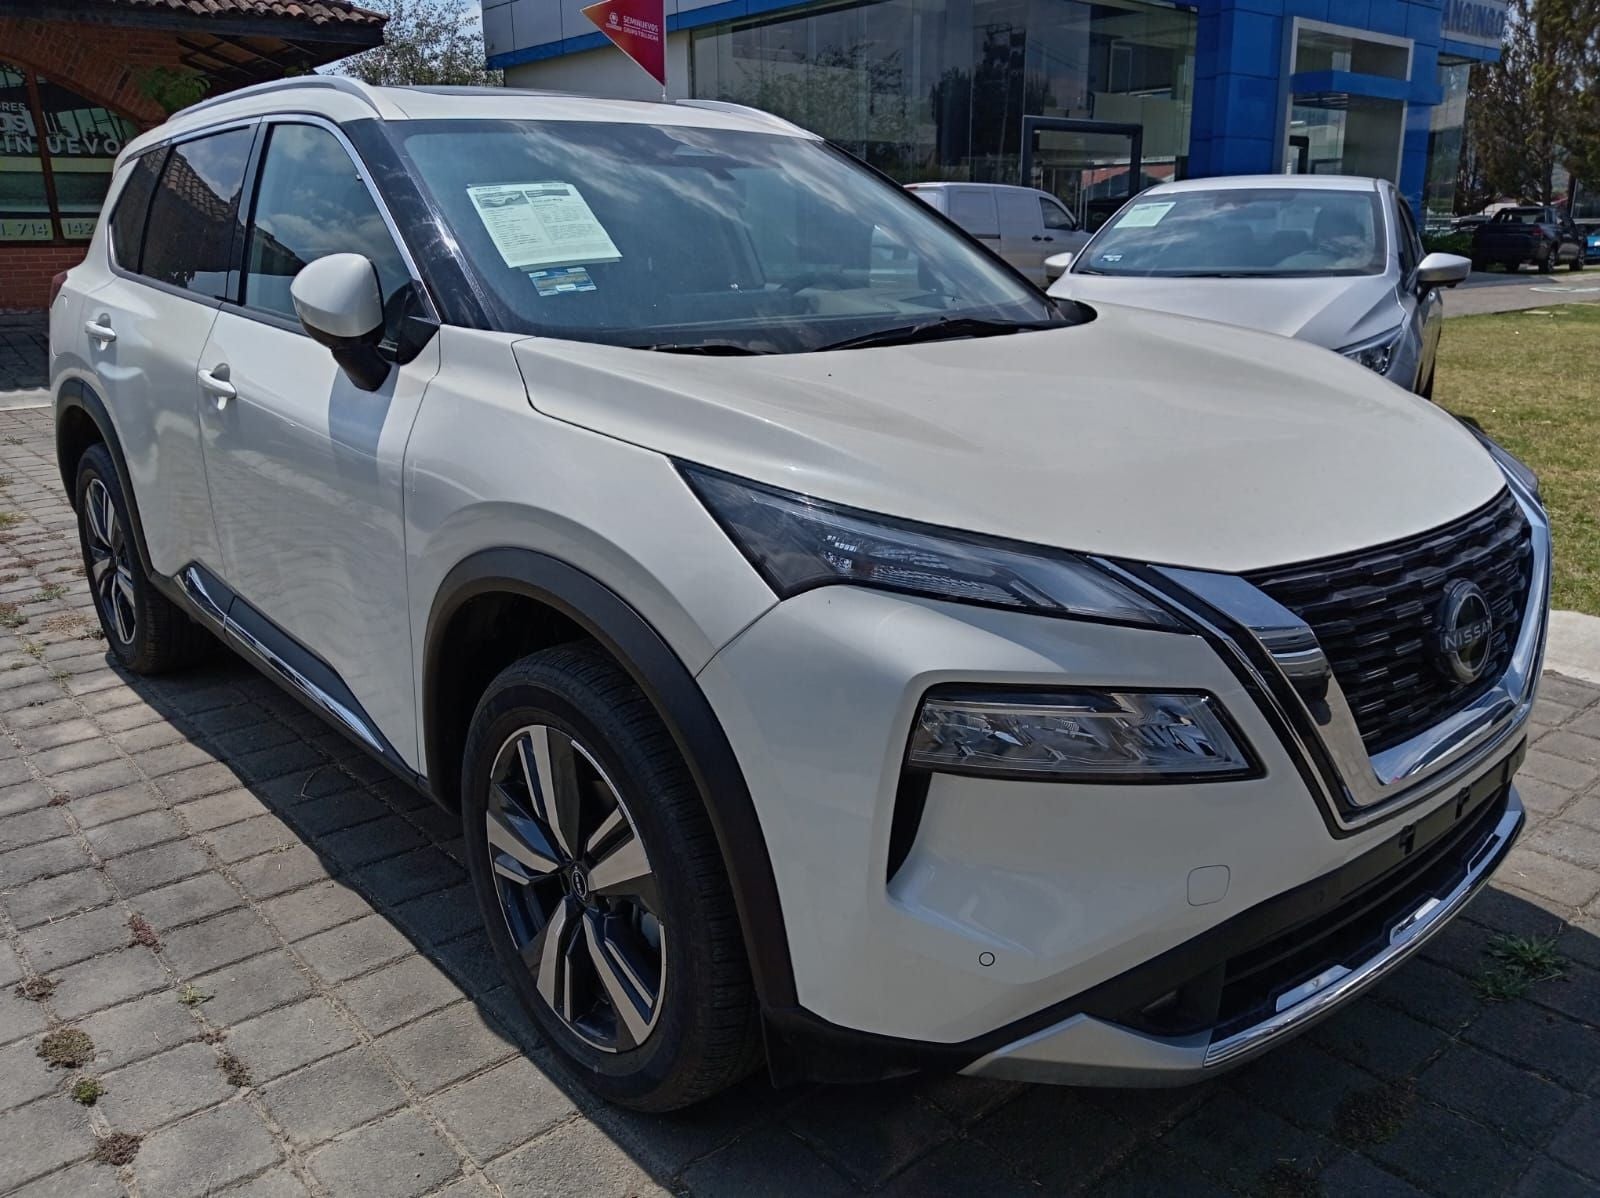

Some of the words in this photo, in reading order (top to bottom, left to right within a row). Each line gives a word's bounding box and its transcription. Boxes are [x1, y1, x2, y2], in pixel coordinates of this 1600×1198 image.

[623, 15, 658, 33] SEMINUEVOS
[0, 102, 26, 112] RES
[1444, 619, 1493, 649] NISSAN
